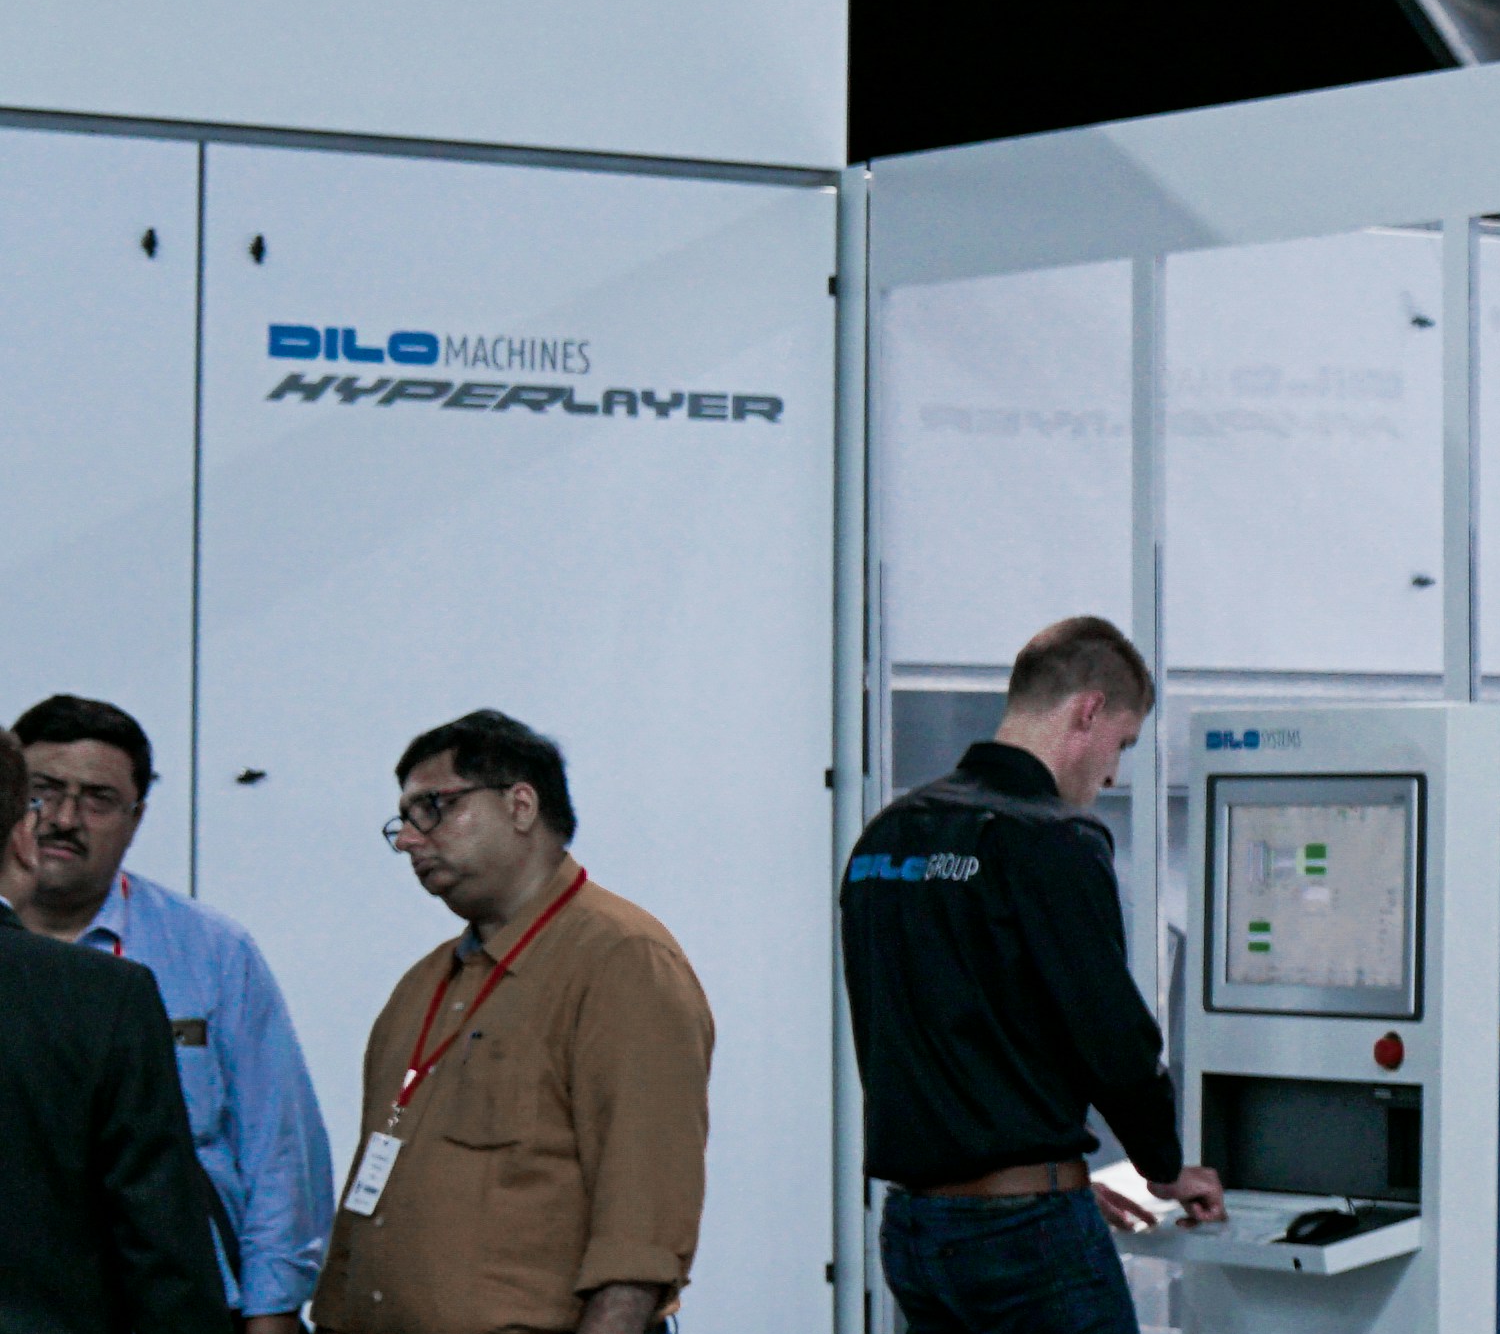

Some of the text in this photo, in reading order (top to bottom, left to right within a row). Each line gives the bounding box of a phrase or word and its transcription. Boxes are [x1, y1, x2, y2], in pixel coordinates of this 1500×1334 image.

[267, 324, 590, 375] DILO MACHINES
[266, 372, 784, 424] HYPERLAYER
[1206, 730, 1260, 749] DILO
[924, 851, 979, 882] GROUP
